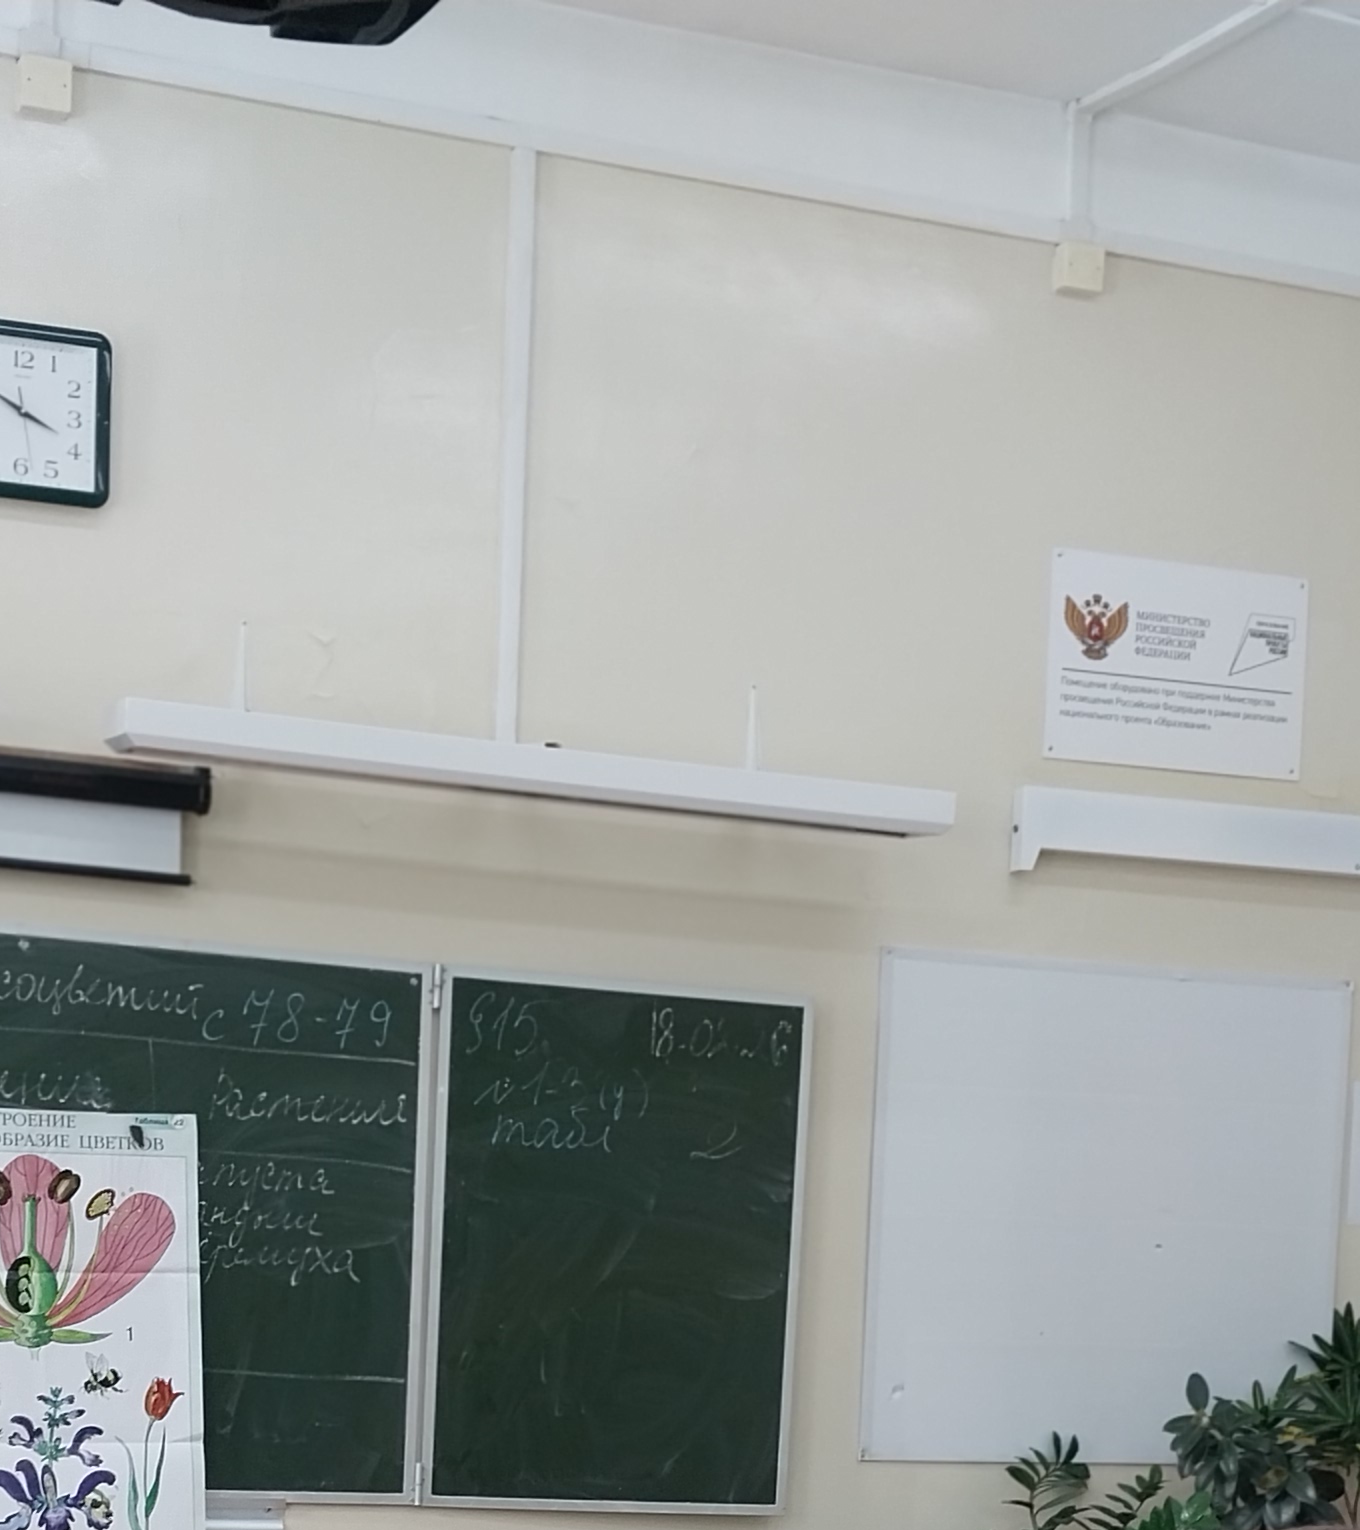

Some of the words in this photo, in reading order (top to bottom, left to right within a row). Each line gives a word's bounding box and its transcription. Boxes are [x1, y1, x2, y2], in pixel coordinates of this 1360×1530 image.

[13, 350, 35, 370] 12
[50, 355, 58, 373] 1
[67, 380, 81, 399] 2
[67, 410, 83, 429] 3
[67, 443, 82, 460] 4
[13, 458, 29, 476] 6
[43, 460, 59, 479] 5
[1136, 610, 1211, 628] МИНИСТЕРСТВО
[1135, 622, 1206, 639] ПРОСВЕЩЕНИЯ
[1134, 634, 1197, 650] РОССИЙСКОЙ
[1134, 646, 1191, 661] ФЕДЕРАЦИИ
[126, 1326, 135, 1343] 1
